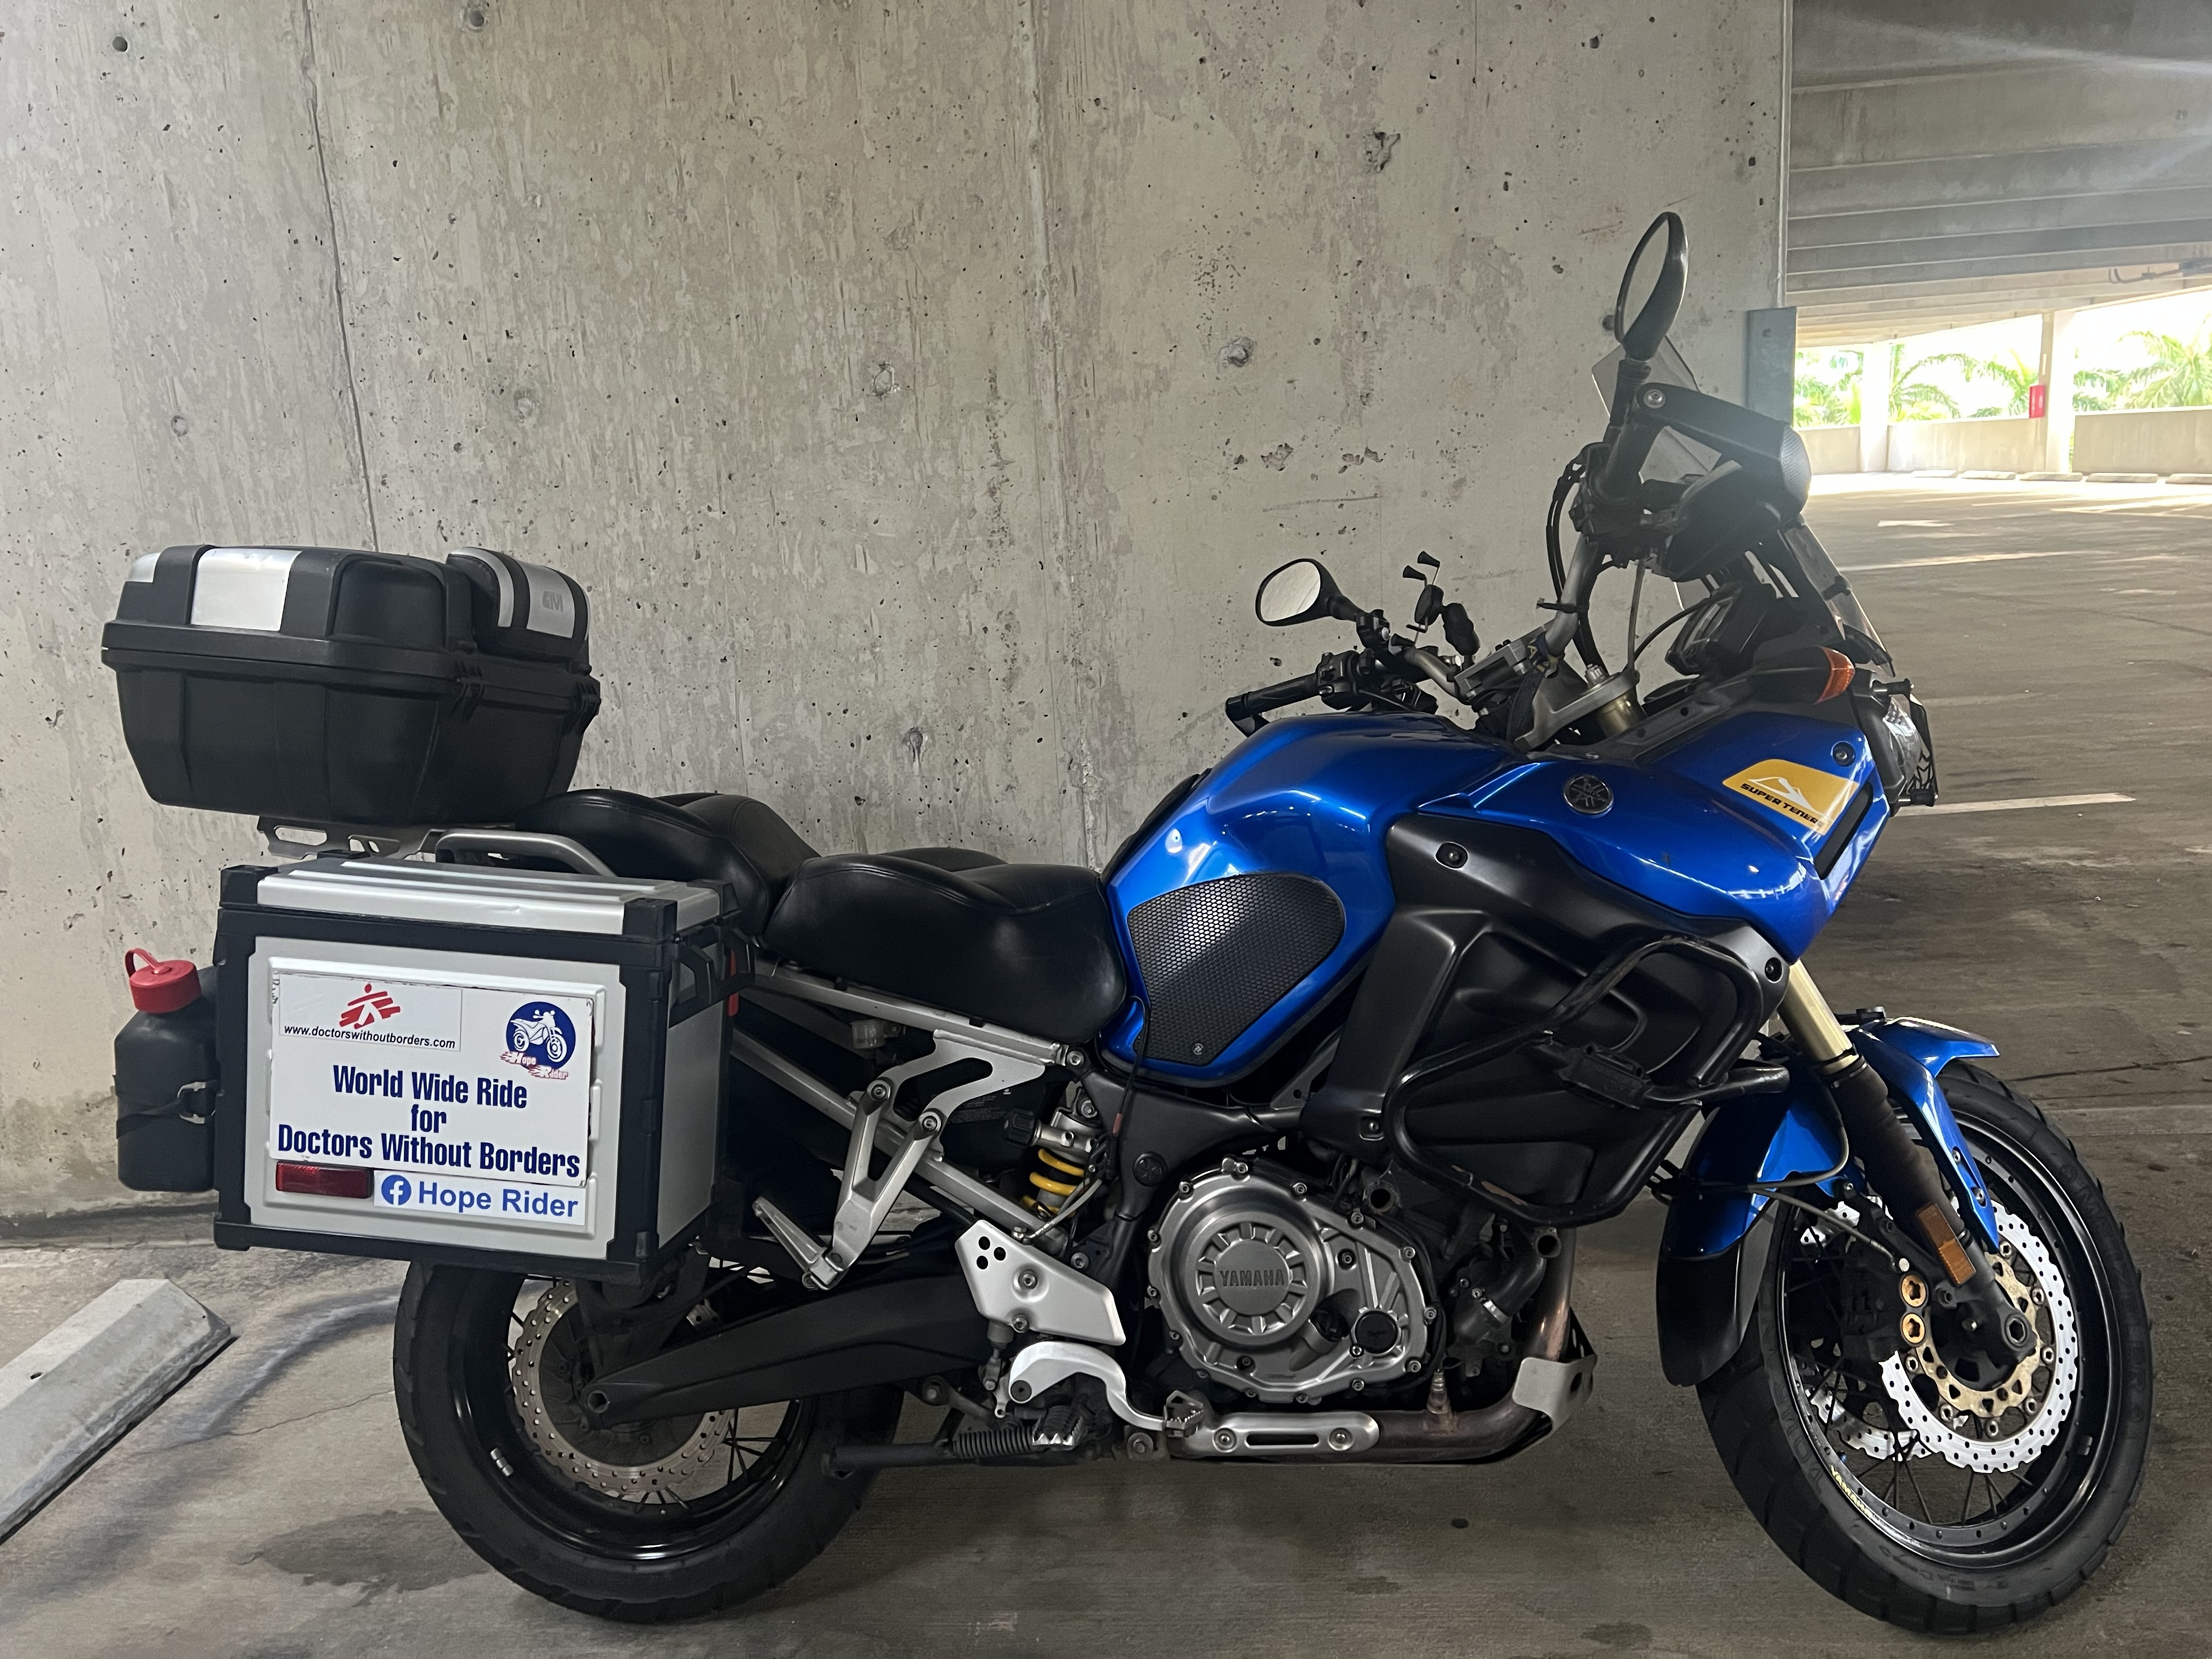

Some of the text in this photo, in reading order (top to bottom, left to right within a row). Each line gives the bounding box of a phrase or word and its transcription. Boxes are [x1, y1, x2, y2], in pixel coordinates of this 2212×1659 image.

[1740, 783, 1782, 805] SUPER
[284, 1025, 455, 1048] www.doctorswithoutborders.com
[511, 1051, 537, 1065] Hope
[538, 1065, 568, 1080] Rider
[332, 1064, 527, 1108] World Wide Ride
[410, 1104, 447, 1133] for
[278, 1124, 580, 1178] Doctors Without Borders
[419, 1181, 492, 1213] Hope
[501, 1188, 578, 1217] Rider
[1220, 1269, 1285, 1286] YAMAHA
